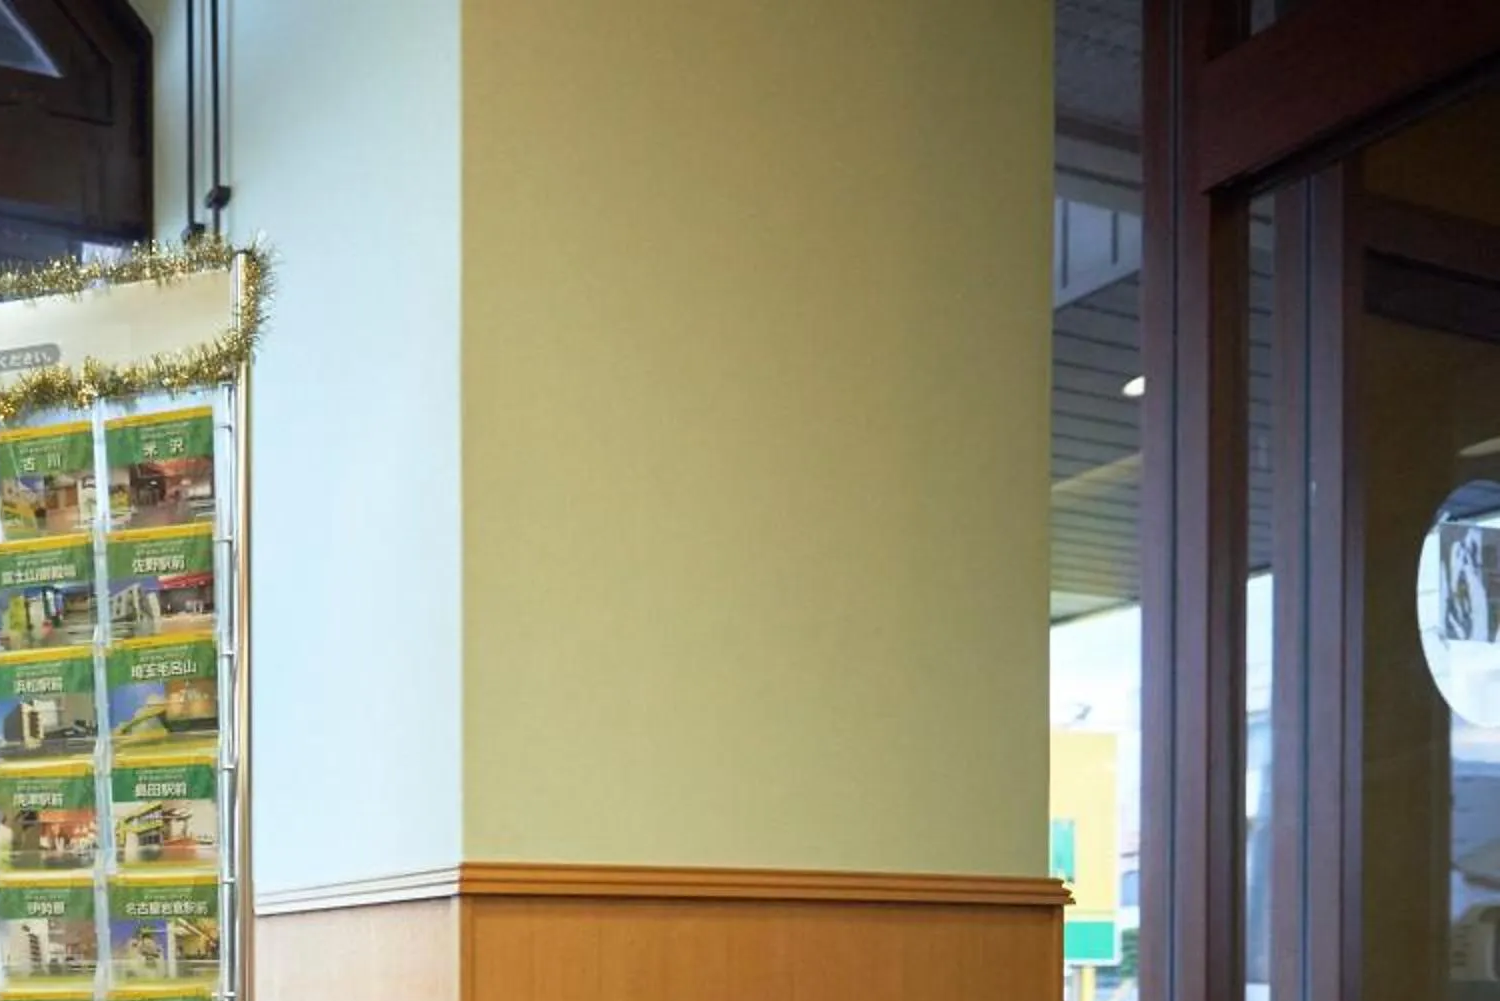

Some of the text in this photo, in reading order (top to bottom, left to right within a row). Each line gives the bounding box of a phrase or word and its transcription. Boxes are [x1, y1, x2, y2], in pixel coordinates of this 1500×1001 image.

[21, 452, 62, 471] 古川
[134, 782, 188, 798] 島田駅前
